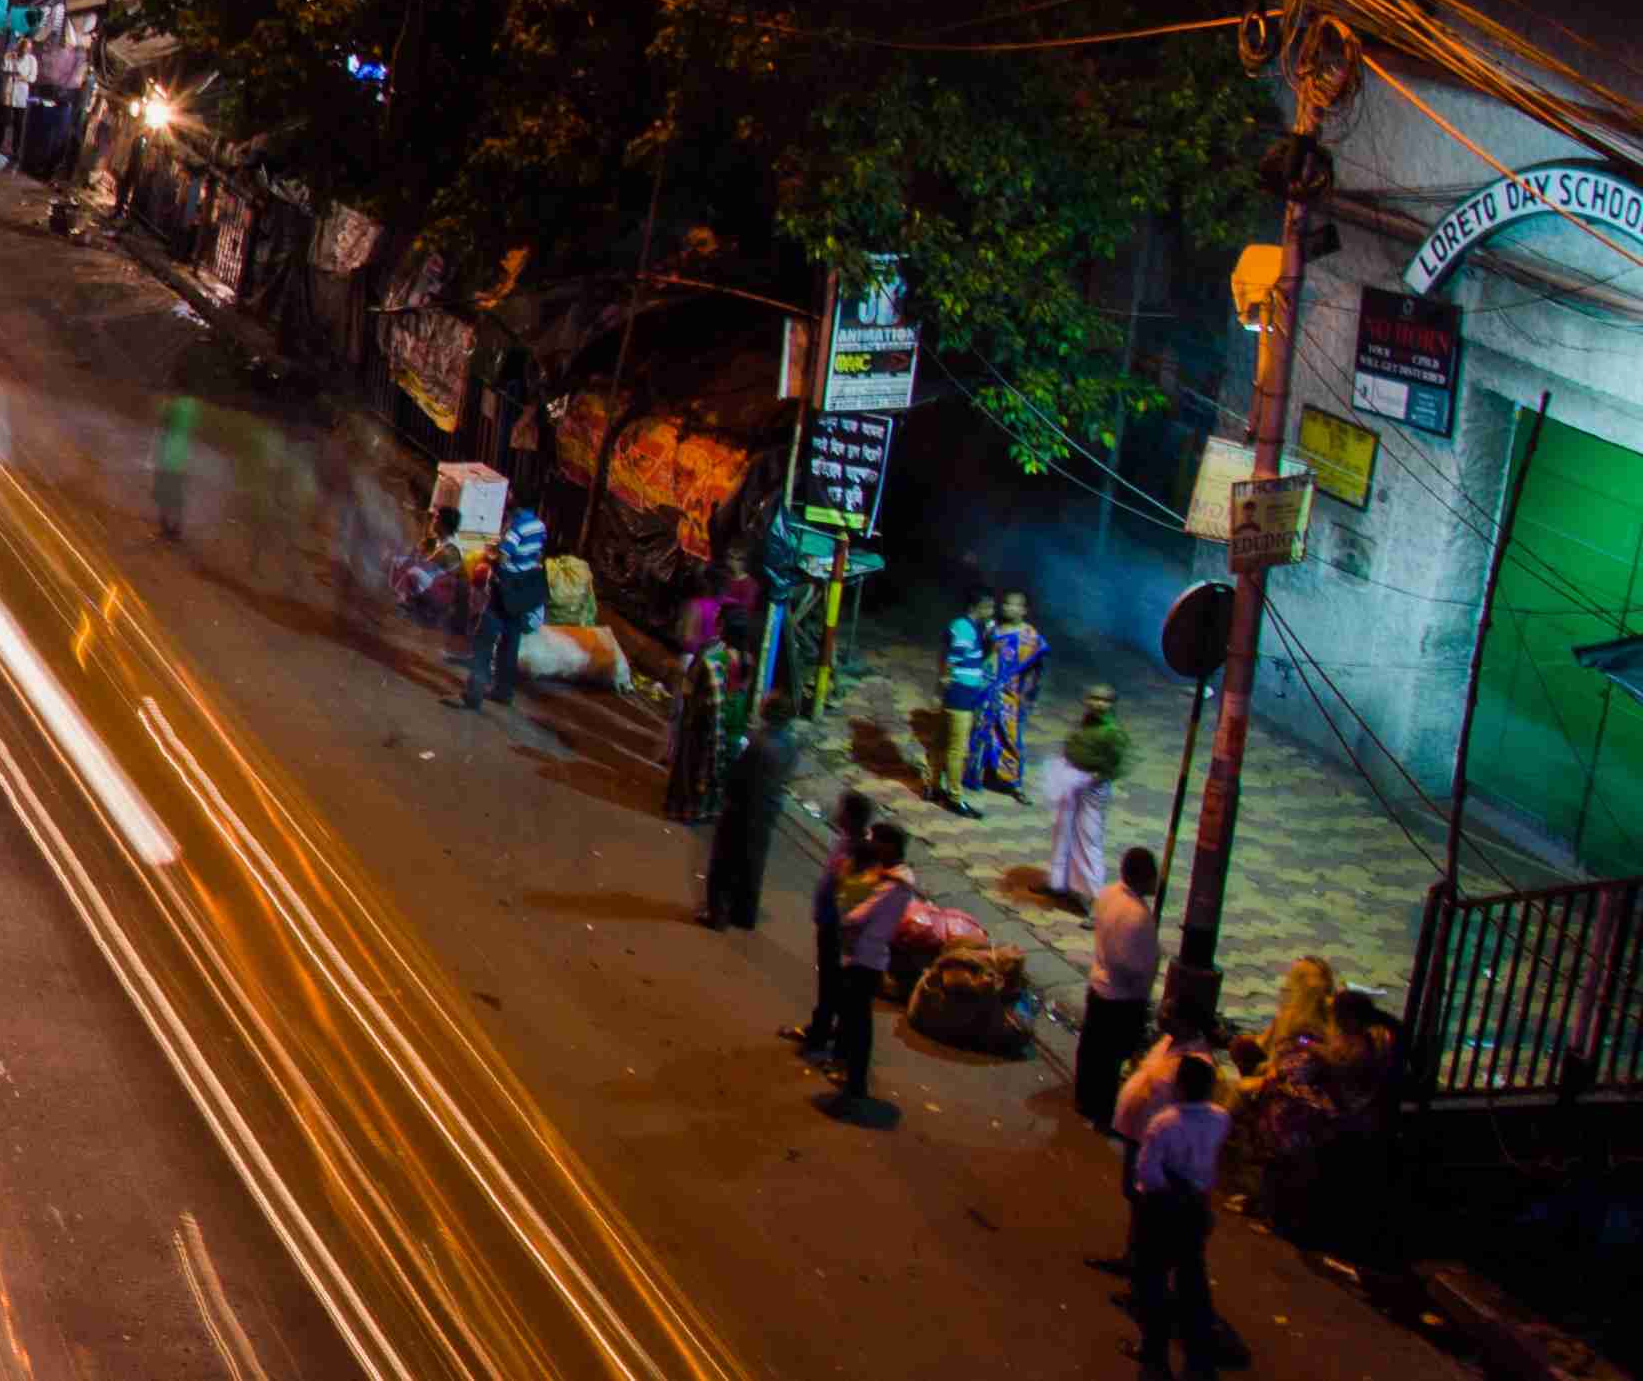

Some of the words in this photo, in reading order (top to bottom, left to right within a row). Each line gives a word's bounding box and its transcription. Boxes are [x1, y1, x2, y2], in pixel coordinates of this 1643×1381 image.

[1418, 191, 1498, 278] LORETO
[1506, 174, 1550, 211] DAY
[1559, 173, 1643, 233] SCHOO
